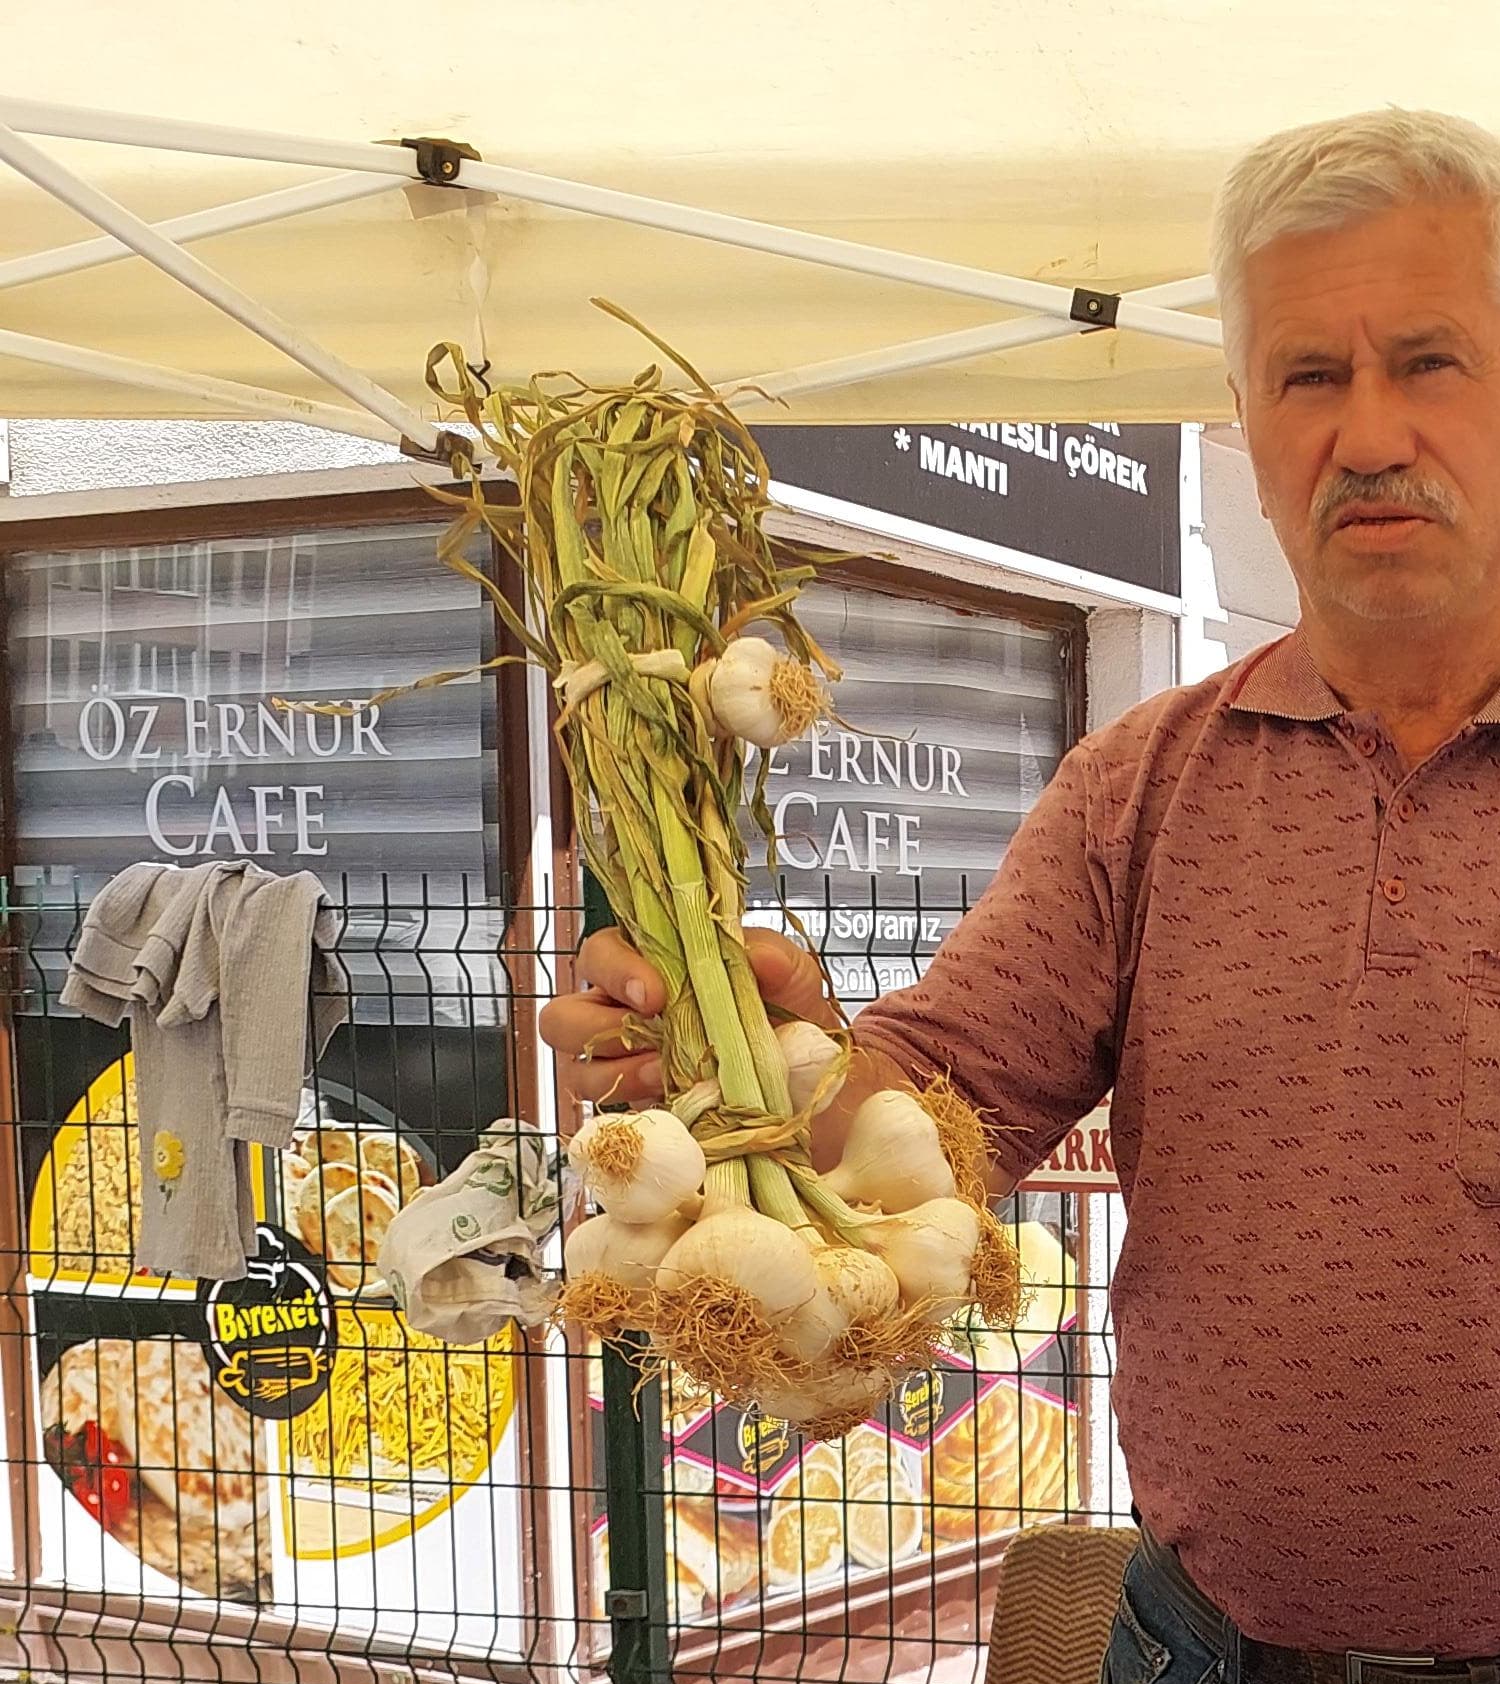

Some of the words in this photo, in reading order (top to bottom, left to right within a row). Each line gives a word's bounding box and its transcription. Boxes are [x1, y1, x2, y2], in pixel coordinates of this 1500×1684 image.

[920, 435, 1008, 496] MANTI
[1063, 434, 1148, 495] ÇÖREK
[78, 683, 161, 760] ÖZ
[184, 696, 392, 757] ERNUR
[808, 720, 969, 797] ERNUR
[146, 775, 327, 856] CAFE
[774, 792, 921, 876] CAFE
